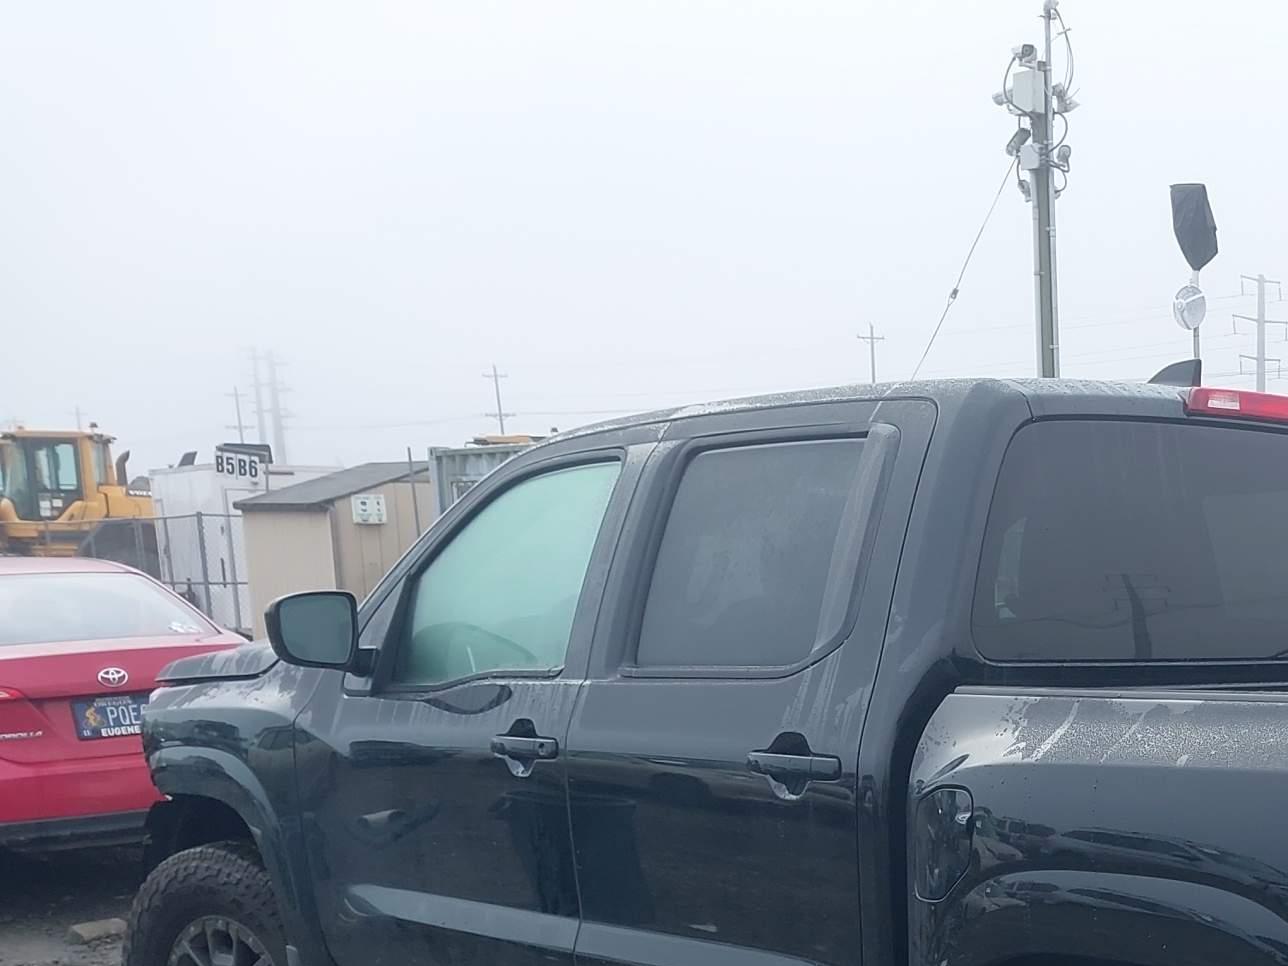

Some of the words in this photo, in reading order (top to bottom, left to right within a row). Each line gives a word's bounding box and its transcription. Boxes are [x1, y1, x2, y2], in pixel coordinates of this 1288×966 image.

[216, 455, 235, 475] B5
[238, 458, 258, 478] B6
[101, 725, 141, 737] EUGENE
